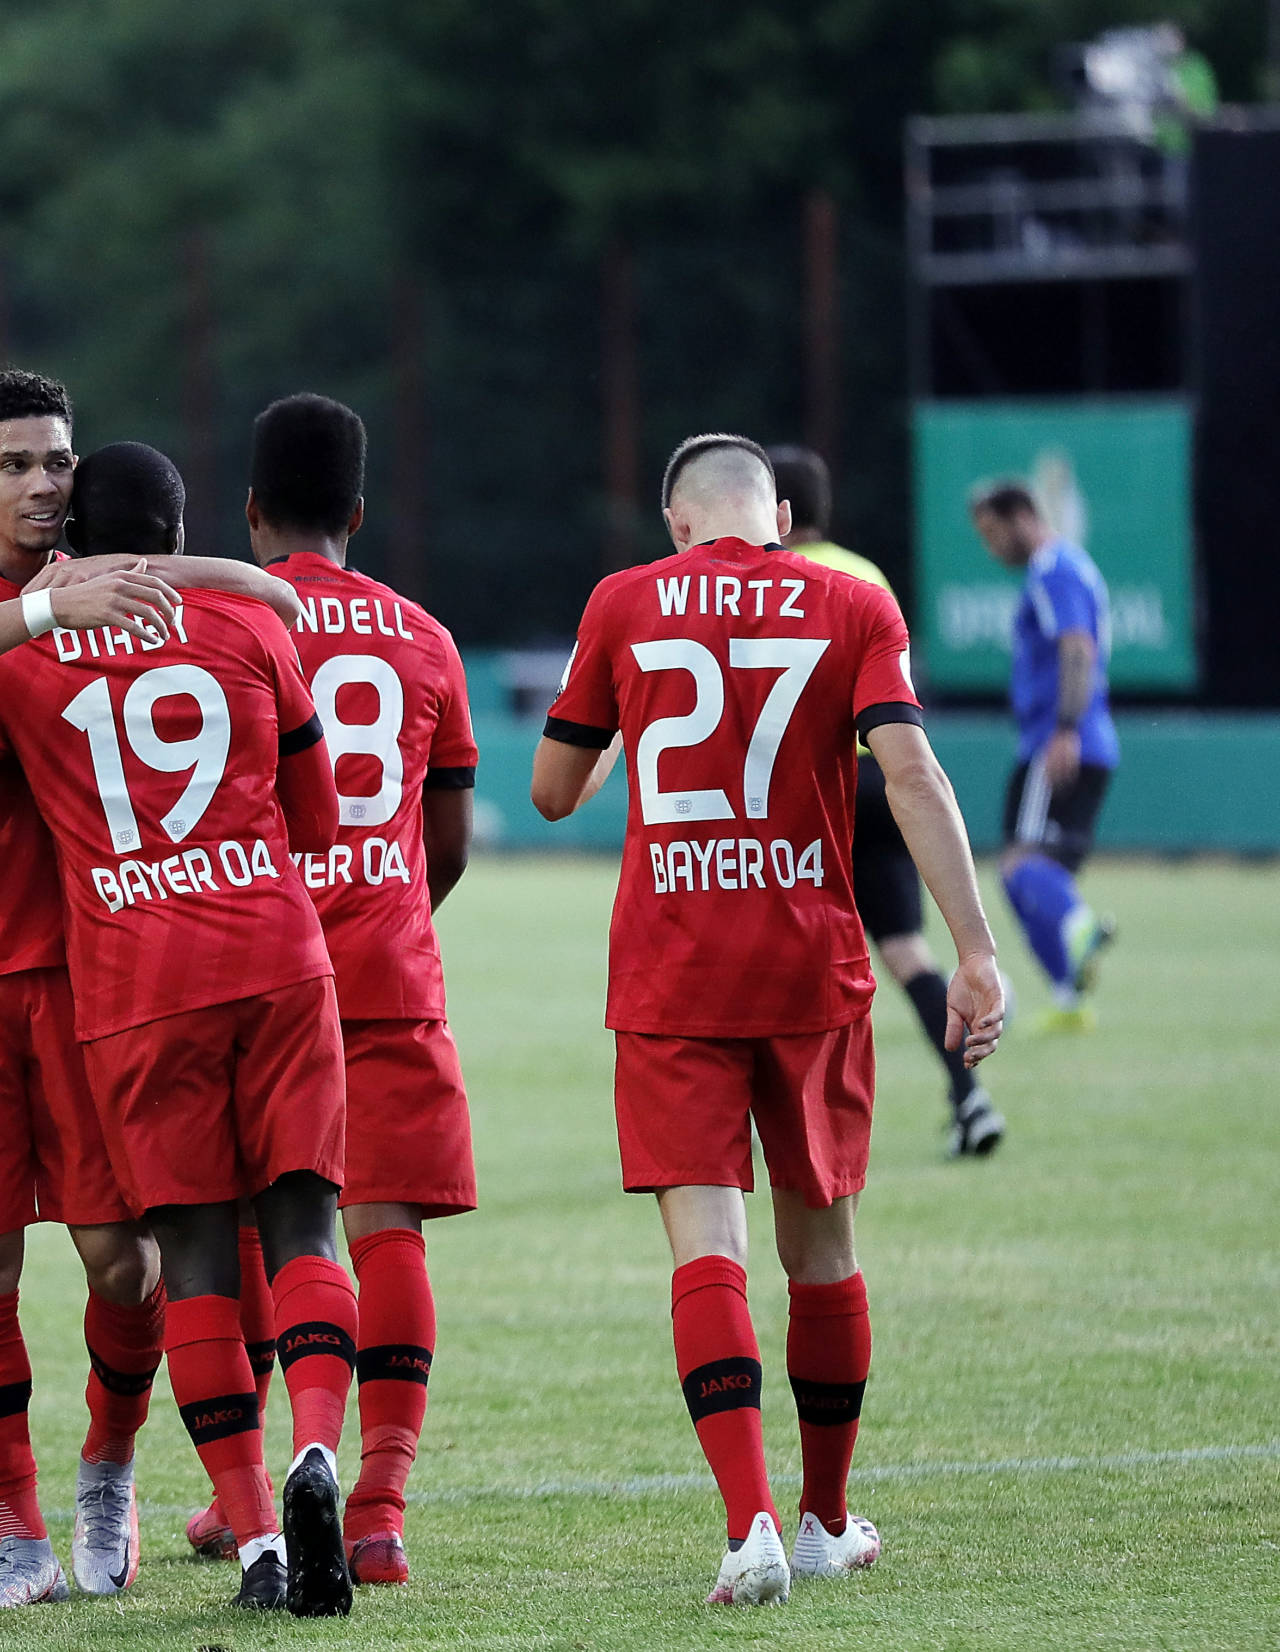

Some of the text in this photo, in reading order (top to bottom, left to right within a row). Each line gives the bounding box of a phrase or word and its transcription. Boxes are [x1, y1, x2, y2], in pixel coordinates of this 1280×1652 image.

[289, 596, 414, 640] NDELL
[656, 574, 806, 619] WIRTZ
[630, 637, 832, 826] 27
[60, 663, 232, 854] 19
[91, 838, 280, 914] BAYER 04
[362, 836, 411, 886] 04
[649, 837, 824, 895] BAYER 04
[285, 1332, 342, 1353] JAKO
[699, 1373, 752, 1398] JAKO
[194, 1408, 244, 1430] JAKO
